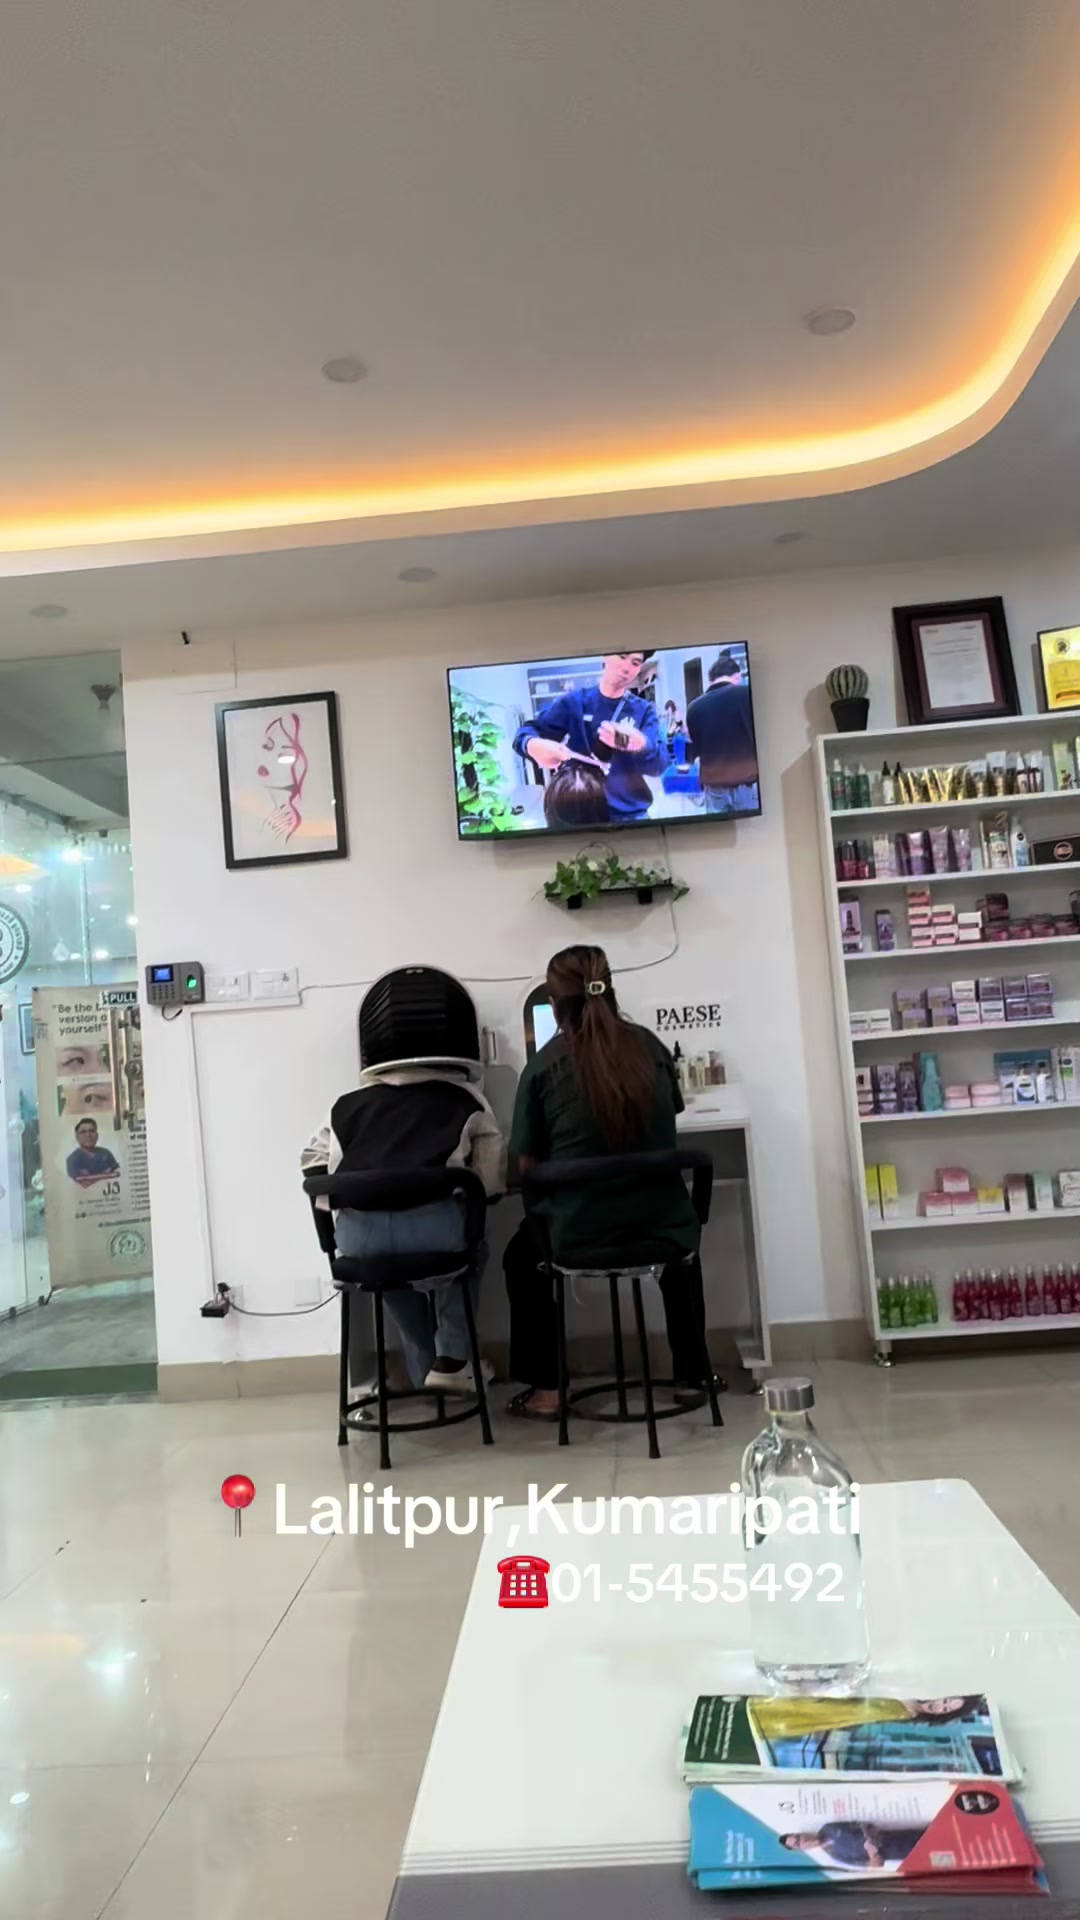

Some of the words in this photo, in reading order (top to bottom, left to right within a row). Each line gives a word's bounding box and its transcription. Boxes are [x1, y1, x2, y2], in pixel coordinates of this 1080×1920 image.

[110, 993, 135, 1002] PULL
[74, 1003, 93, 1012] the
[59, 1014, 98, 1023] version
[656, 1004, 721, 1025] PAESE
